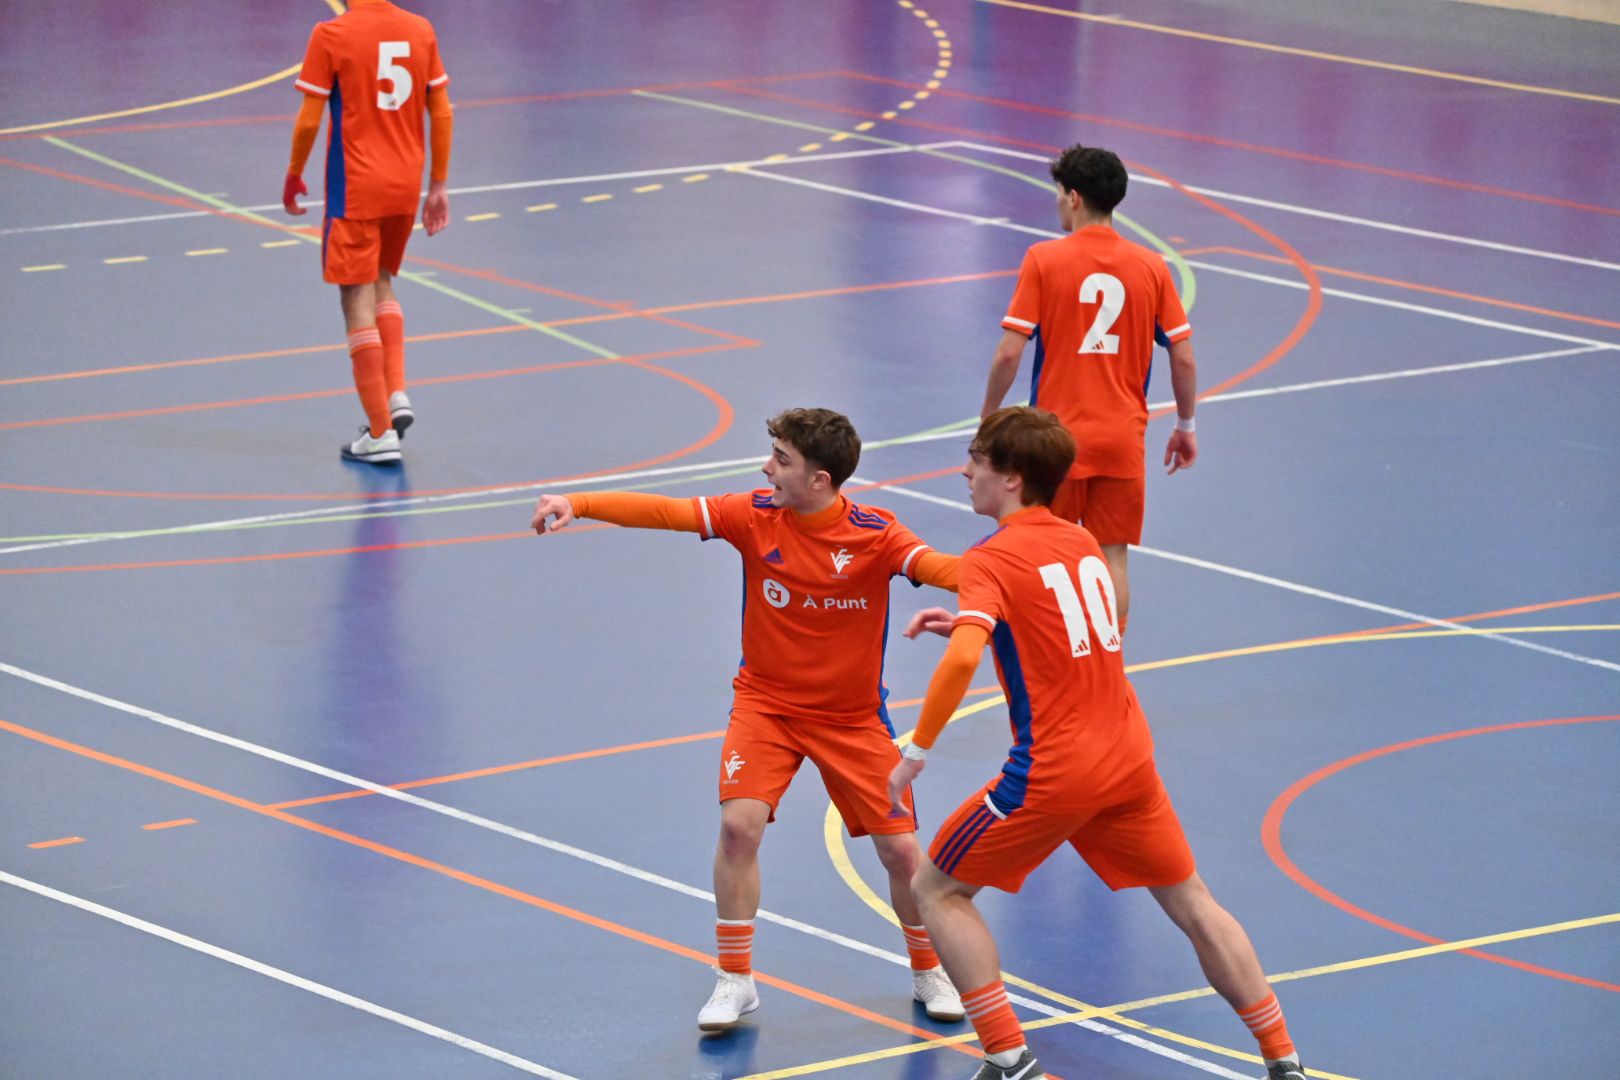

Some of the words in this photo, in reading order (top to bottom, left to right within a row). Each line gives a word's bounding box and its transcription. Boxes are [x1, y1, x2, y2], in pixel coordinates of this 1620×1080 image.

[377, 41, 413, 111] 5
[1078, 272, 1126, 355] 2
[802, 594, 818, 609] À
[823, 597, 868, 610] Punt
[1038, 555, 1121, 658] 10
